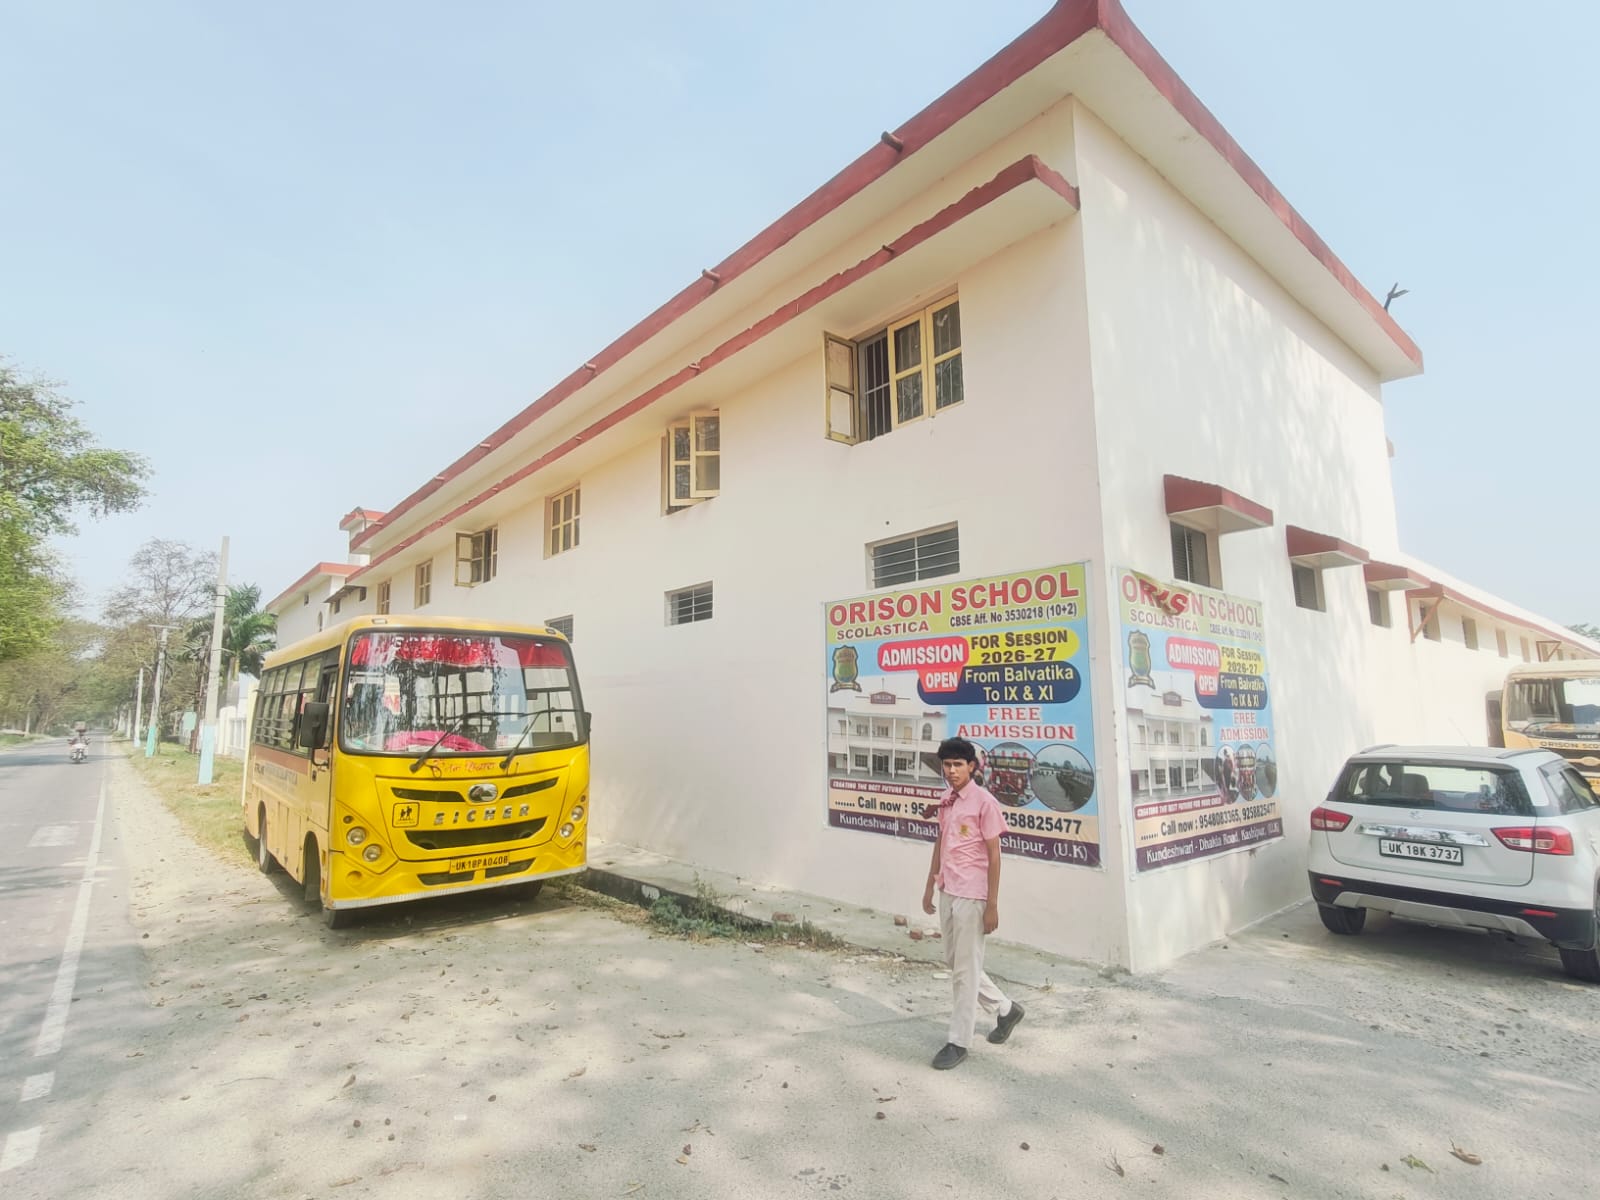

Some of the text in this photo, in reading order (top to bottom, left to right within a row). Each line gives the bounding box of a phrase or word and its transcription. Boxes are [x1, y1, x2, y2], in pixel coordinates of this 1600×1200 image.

[829, 572, 1079, 626] ORISON SCHOOL
[950, 614, 972, 628] CBSE
[990, 611, 1003, 623] No
[1005, 606, 1044, 622] 3530218
[1046, 602, 1078, 620] (10+2)
[1130, 609, 1199, 632] SCOLASTICA
[1209, 597, 1262, 628] SCHOOL
[837, 621, 929, 640] SCOLASTICA
[971, 630, 1068, 650] FOR SESSION
[881, 644, 964, 667] ADMISSION
[980, 647, 1057, 665] 2026-27
[1169, 644, 1220, 667] ADMISSION
[1221, 647, 1235, 658] FOR
[965, 665, 1074, 684] From Balvatika
[1227, 662, 1258, 674] 2026-27
[925, 670, 959, 689] OPEN
[1199, 675, 1217, 692] OPEN
[1220, 676, 1237, 689] From
[983, 685, 1053, 702] To IX & XI
[988, 707, 1041, 721] FREE
[1234, 712, 1256, 724] FREE
[957, 724, 1075, 740] ADMISSION
[1220, 728, 1269, 741] ADMISSION
[433, 803, 530, 826] EICHER
[857, 796, 877, 810] Call
[880, 801, 902, 813] now
[1002, 812, 1082, 834] 258825477
[840, 813, 899, 832] Kundeshwari
[908, 822, 938, 838] Dhaki
[1001, 835, 1048, 855] shipur,
[1053, 842, 1088, 860] (U.K)
[1160, 820, 1177, 836] Call
[1178, 821, 1193, 833] now
[1389, 842, 1459, 860] UK 18K 3737
